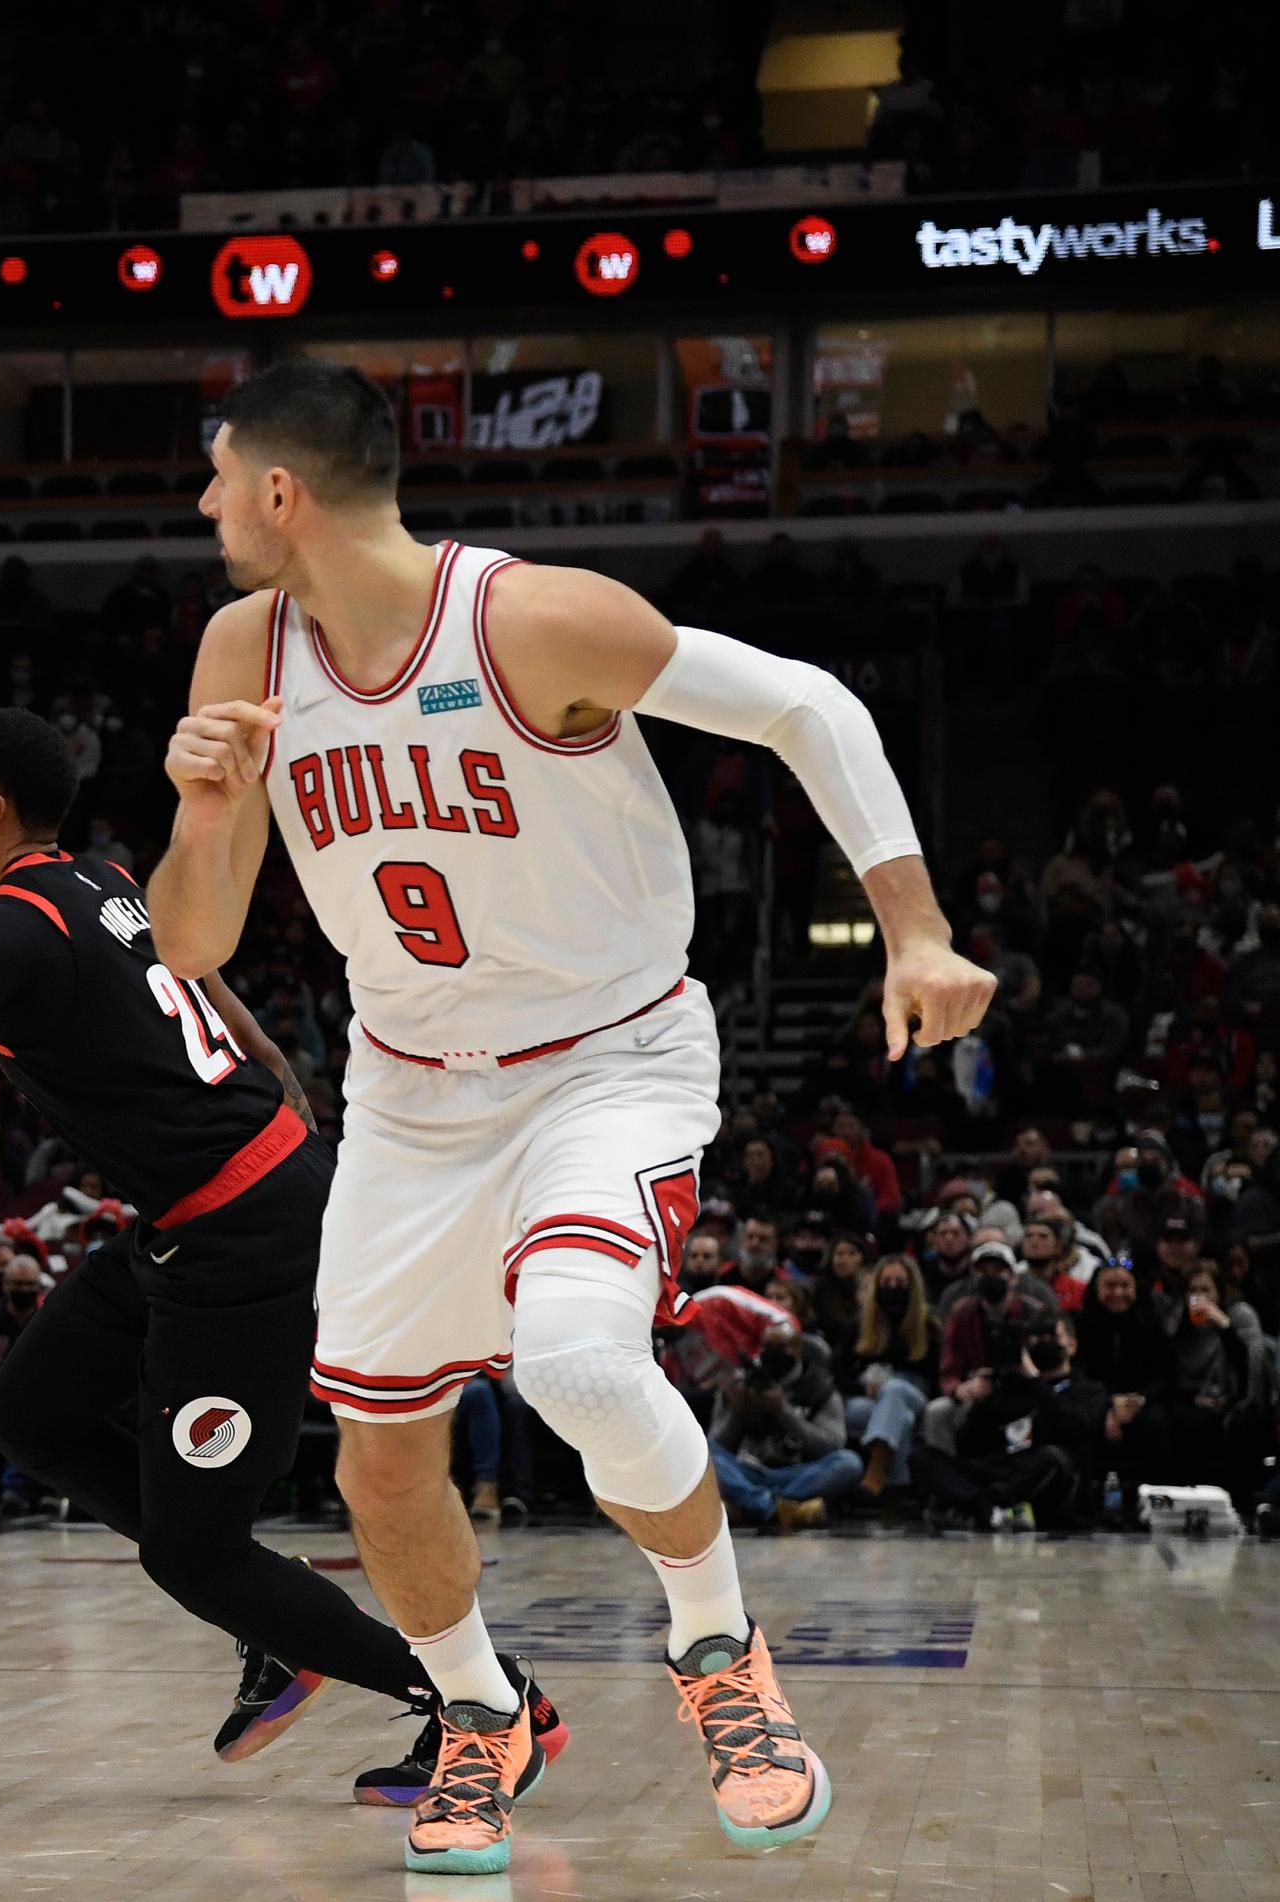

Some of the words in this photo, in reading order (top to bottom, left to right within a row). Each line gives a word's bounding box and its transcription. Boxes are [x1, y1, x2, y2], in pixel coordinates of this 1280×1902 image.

[227, 254, 299, 305] tw
[916, 208, 1221, 276] tastyworks.
[289, 744, 521, 852] BULLS
[372, 861, 471, 969] 9
